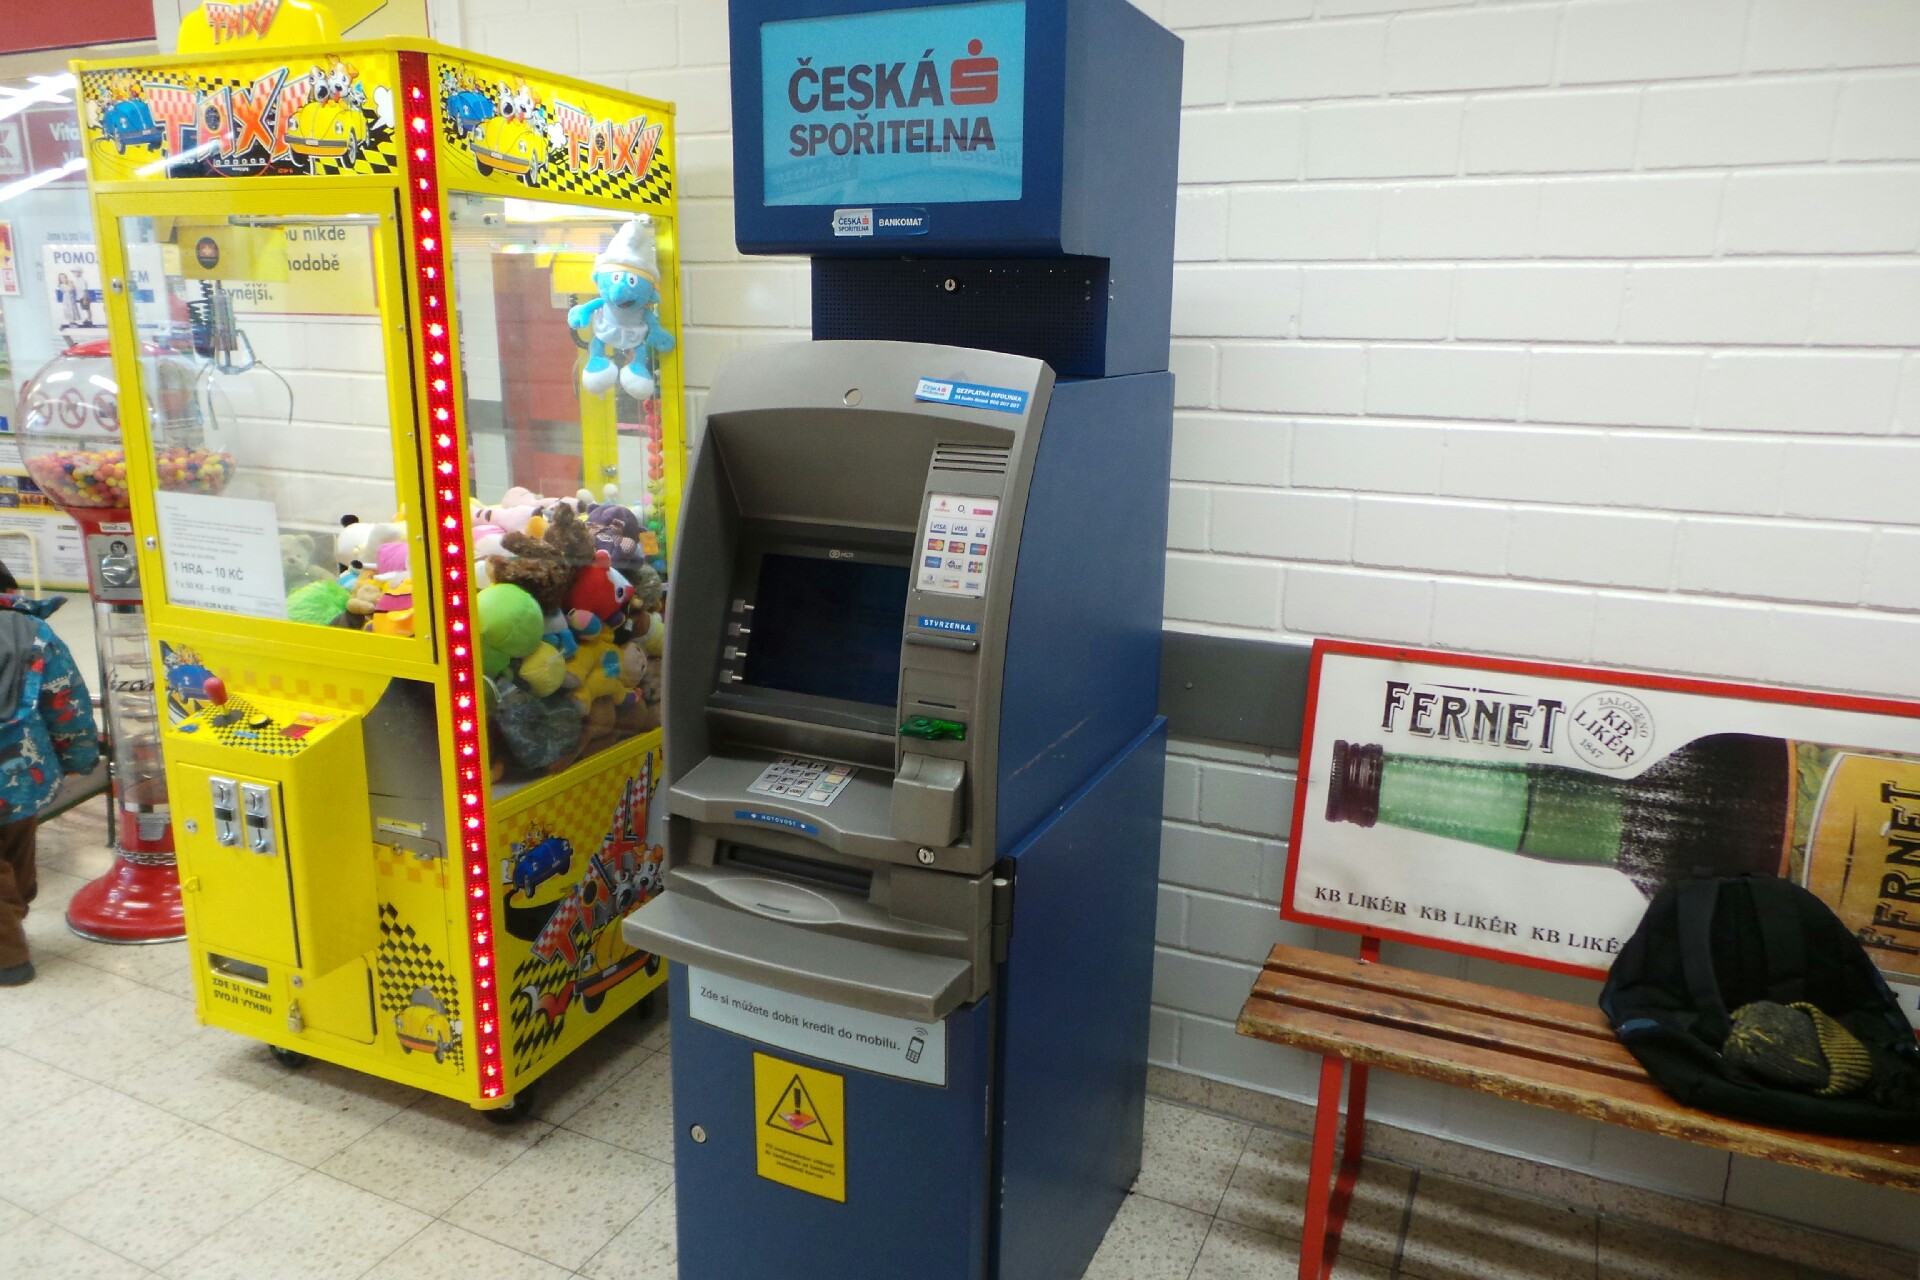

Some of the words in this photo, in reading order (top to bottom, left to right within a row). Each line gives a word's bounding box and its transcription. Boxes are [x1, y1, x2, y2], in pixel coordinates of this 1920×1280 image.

[205, 0, 282, 44] TAXI
[788, 48, 945, 114] ČESKÁ
[144, 67, 311, 162] TAXI
[554, 100, 663, 184] TAXI
[788, 112, 996, 157] SPOŘITELNA
[303, 225, 346, 241] nikde
[838, 215, 862, 226] ČESKÁ
[878, 217, 923, 227] BANKOMAT
[53, 251, 99, 265] POMO
[956, 387, 989, 397] BEZPLATNÁ
[990, 392, 1022, 402] INFOLINKA
[181, 562, 204, 575] HRA
[215, 567, 226, 579] 10
[228, 566, 244, 581] KČ
[924, 619, 971, 631] STVRZENKA
[1381, 680, 1565, 754] FERNET
[1598, 696, 1649, 739] ZALOŽENO
[1601, 709, 1633, 737] KB
[1574, 709, 1636, 764] LIKÉR
[1579, 737, 1604, 759] 1847
[761, 815, 797, 826] HOTOVOST
[1315, 886, 1341, 903] KB
[1348, 891, 1407, 915] LIKÉR
[1420, 905, 1447, 922] KB
[1454, 911, 1518, 936] LIKÉR
[1532, 926, 1560, 944] KB
[1568, 932, 1623, 955] LIKÉ
[212, 977, 229, 989] ZDE
[232, 983, 240, 992] SI
[243, 986, 272, 1002] VEZMI
[700, 986, 718, 1001] Zde
[720, 994, 729, 1005] si
[731, 998, 769, 1018] můžete
[771, 1010, 799, 1026] dobít
[802, 1017, 836, 1036] kredit
[838, 1027, 853, 1040] do
[855, 1032, 900, 1051] mobilu.
